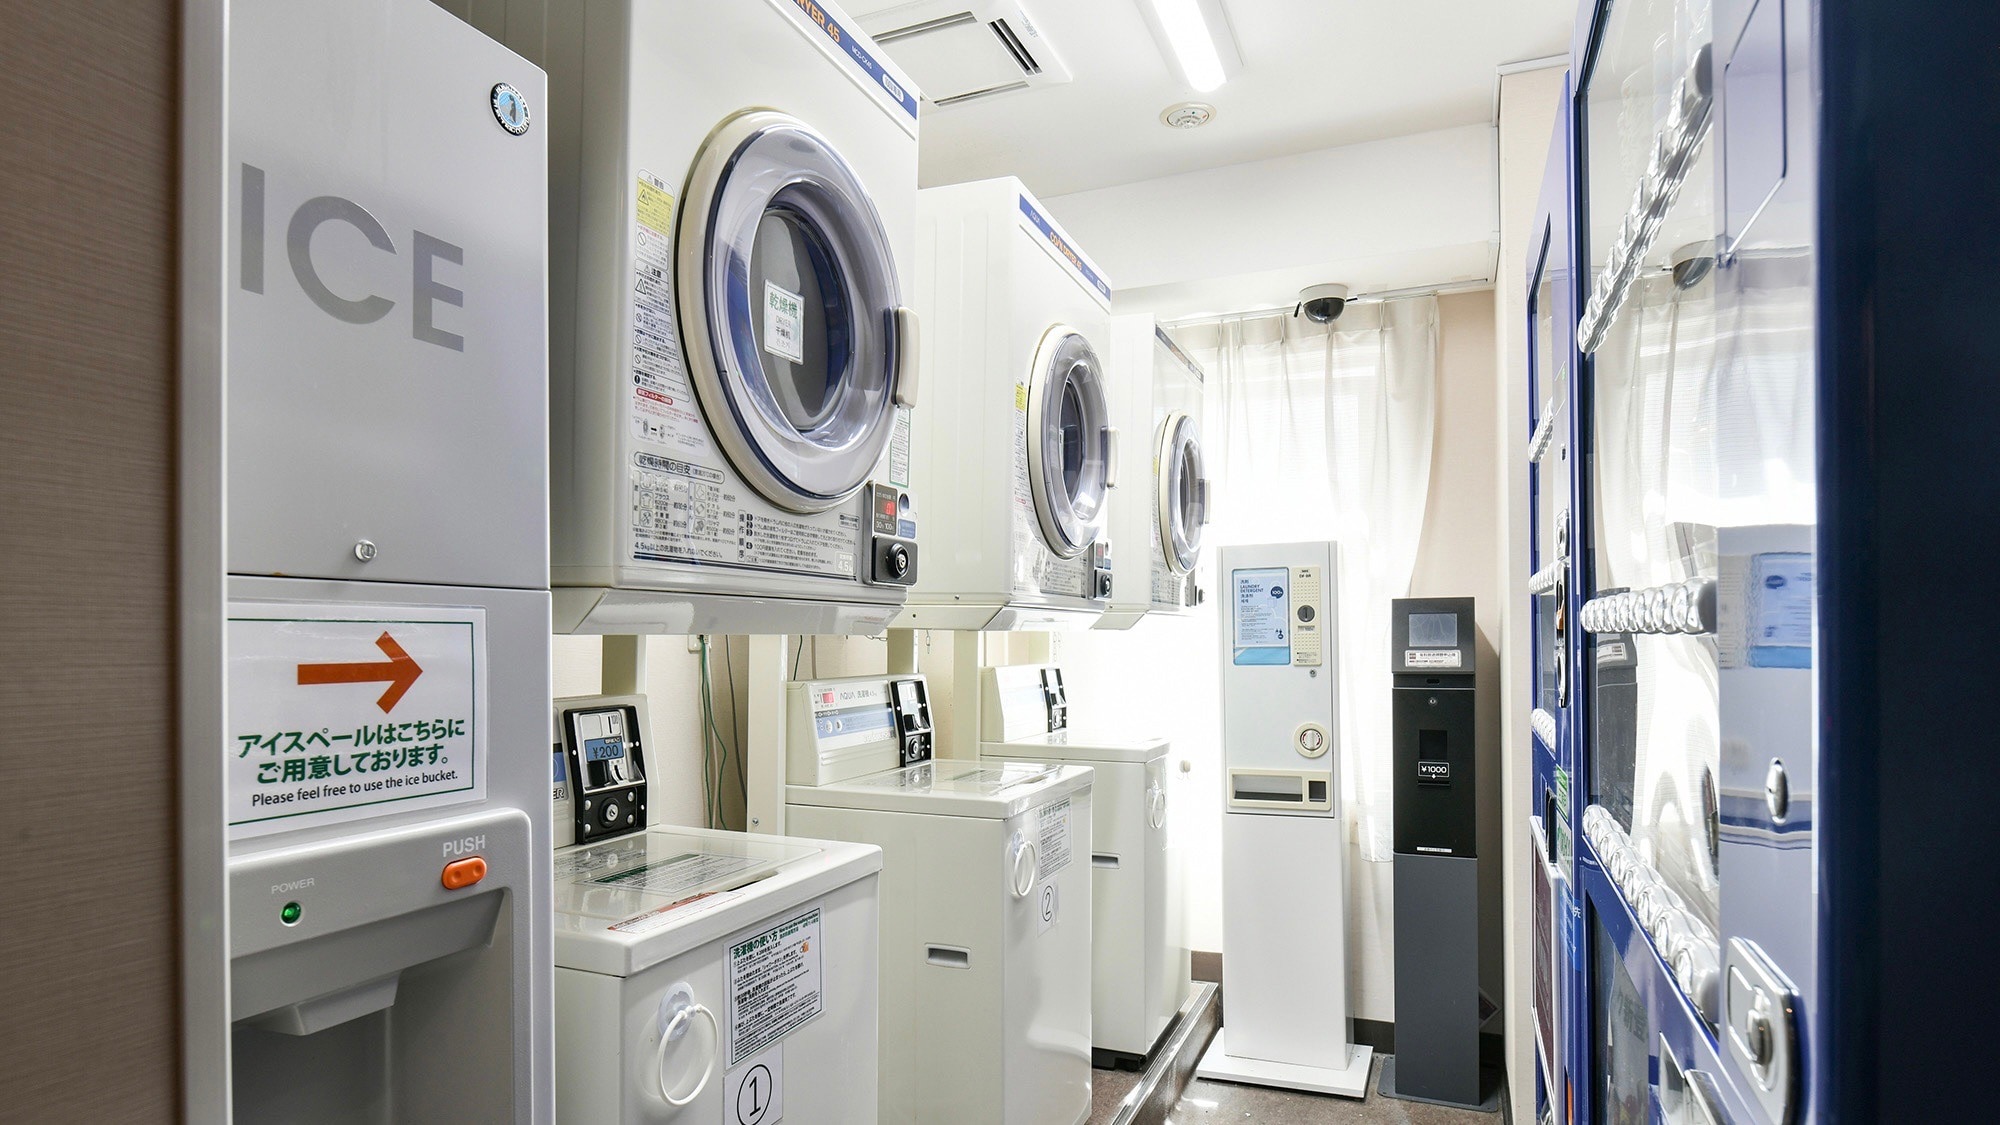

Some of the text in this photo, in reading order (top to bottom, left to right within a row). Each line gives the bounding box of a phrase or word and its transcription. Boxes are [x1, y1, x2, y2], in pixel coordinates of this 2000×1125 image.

[827, 22, 840, 42] 45
[240, 162, 464, 353] ICE
[769, 292, 798, 320] 乾燥機
[840, 692, 855, 700] AQUA
[238, 719, 465, 758] アイスペールはこちらに
[257, 743, 448, 784] ご用意しております。
[593, 745, 619, 759] ¥200
[1421, 765, 1447, 774] ¥1000
[252, 770, 458, 806] Please feel free to use the ice bucket.
[442, 834, 486, 858] PUSH
[271, 877, 315, 894] POWER
[733, 930, 778, 959] 洗濯機の使い方
